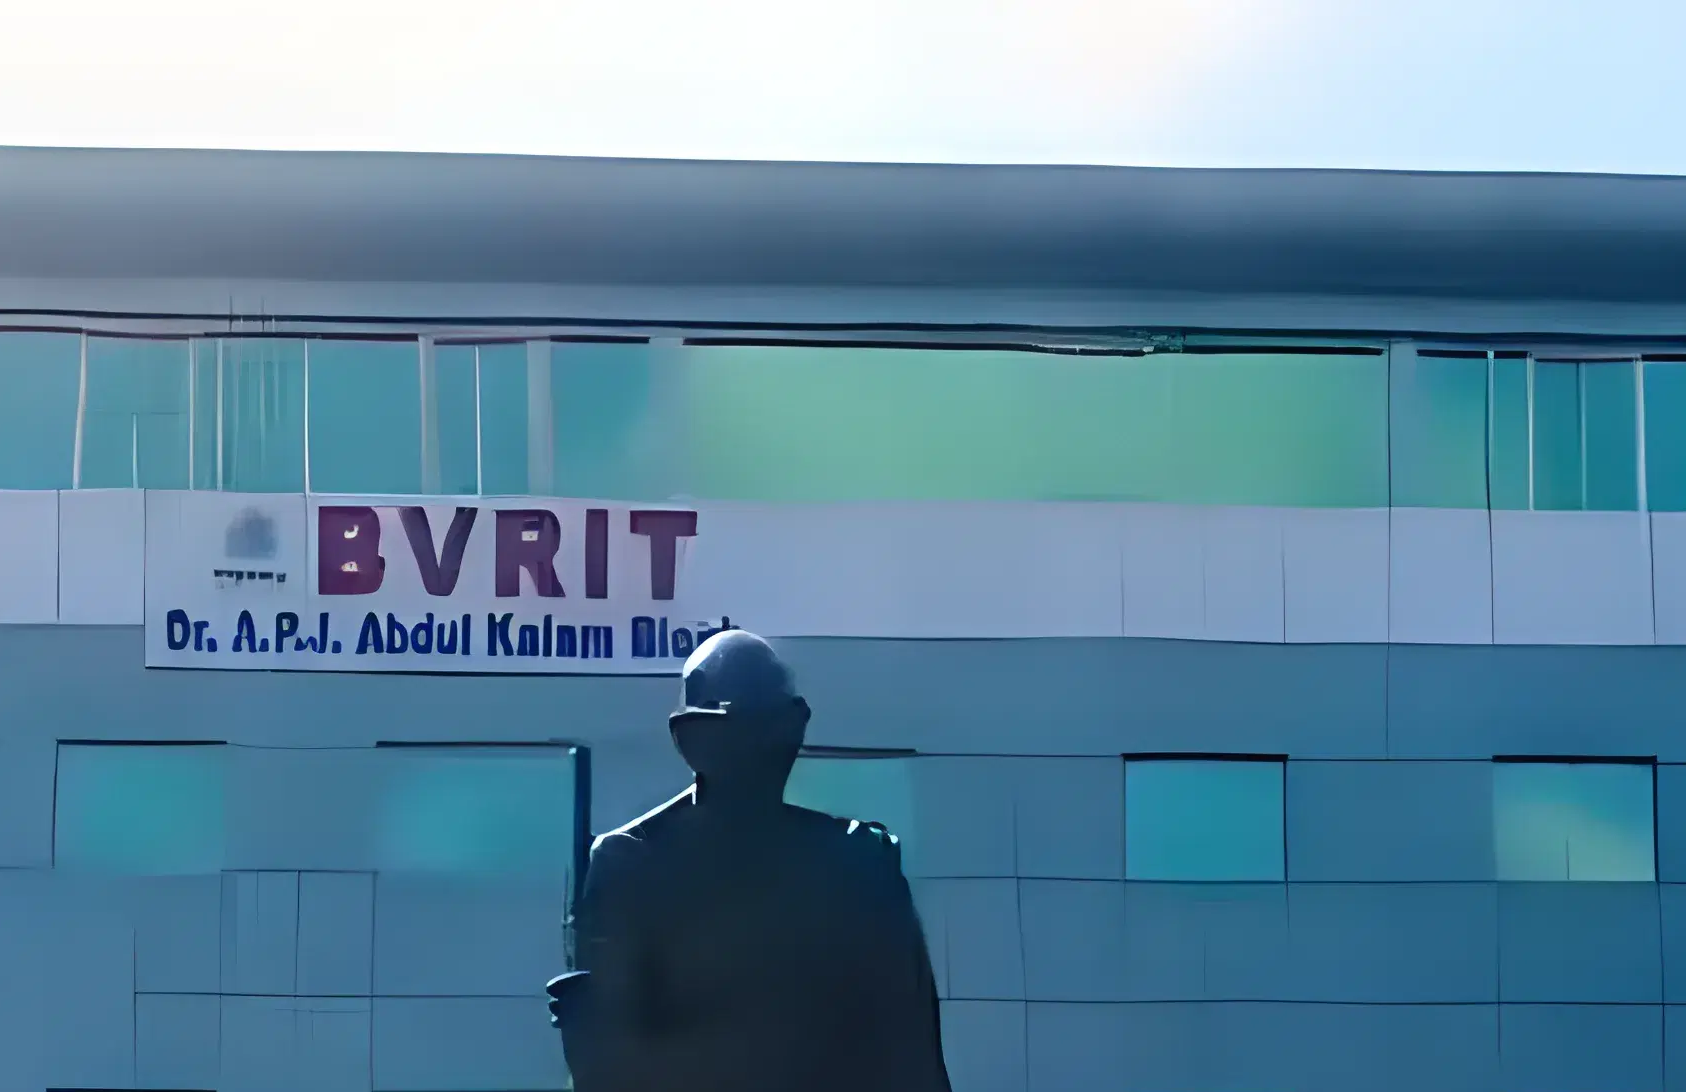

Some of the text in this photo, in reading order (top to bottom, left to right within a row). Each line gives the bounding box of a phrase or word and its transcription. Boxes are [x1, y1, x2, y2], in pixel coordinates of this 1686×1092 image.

[318, 505, 698, 600] BVRIT
[167, 608, 217, 652] Dr.
[355, 611, 470, 655] Abdul
[631, 613, 740, 659] Blo
